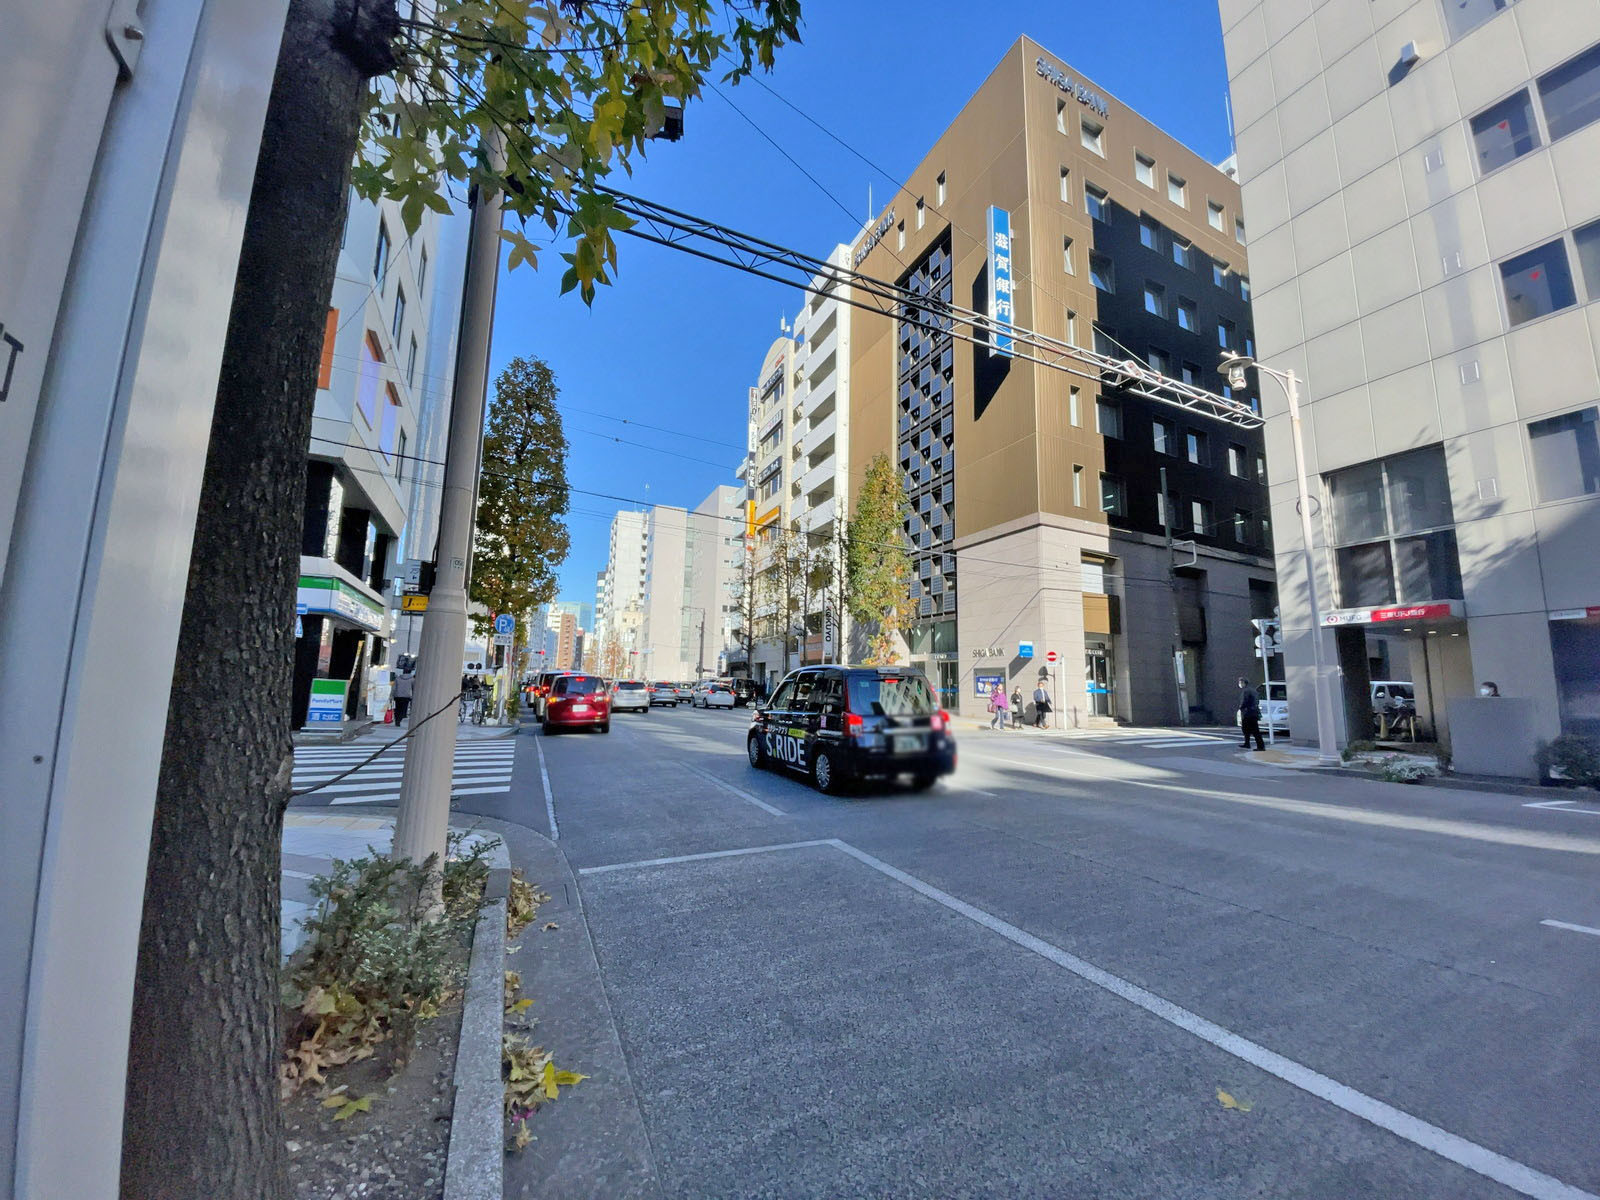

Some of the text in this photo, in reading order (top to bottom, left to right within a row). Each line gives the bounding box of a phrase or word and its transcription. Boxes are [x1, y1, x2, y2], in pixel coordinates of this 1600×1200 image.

[994, 232, 1011, 316] 滋賀銀行
[1339, 614, 1362, 622] MUFG
[972, 647, 1005, 658] SHIGA BANK
[766, 732, 806, 766] S.RIDE
